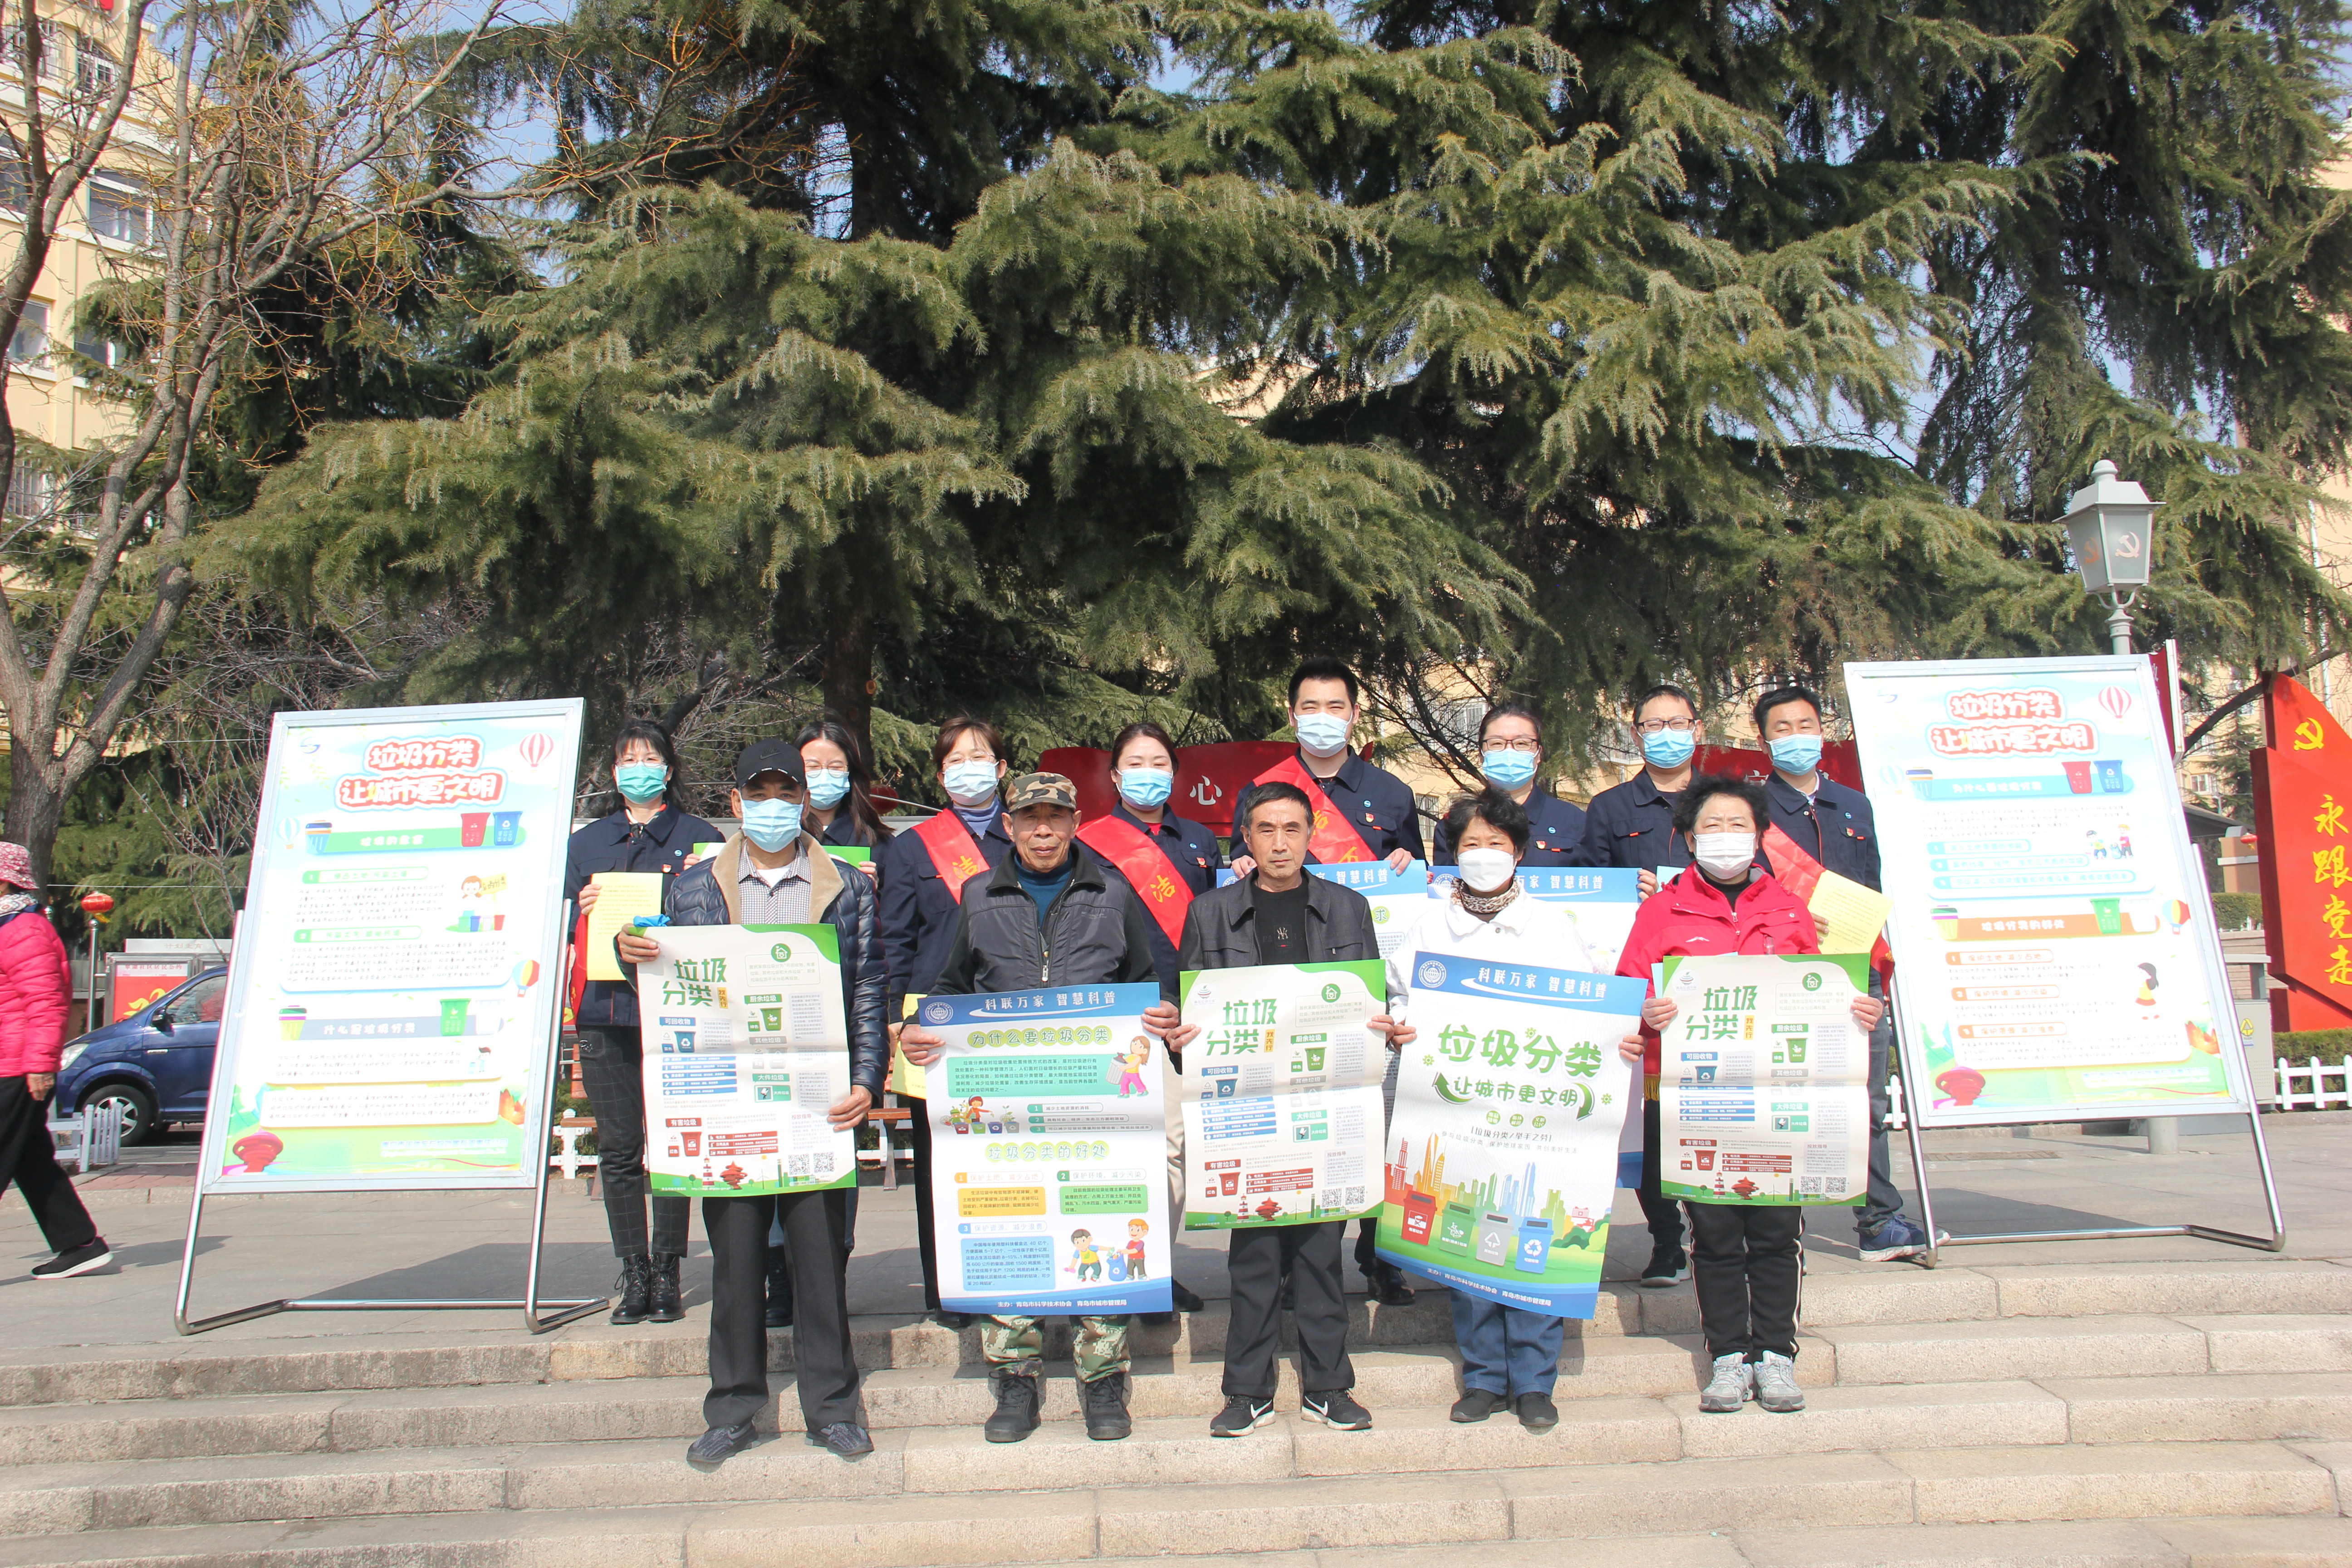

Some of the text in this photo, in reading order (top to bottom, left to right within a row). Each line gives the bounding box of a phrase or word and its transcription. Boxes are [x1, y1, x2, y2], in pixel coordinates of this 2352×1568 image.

[1952, 693, 2055, 717] 垃圾分类
[1932, 725, 2088, 751] 让城市更文明
[371, 740, 474, 768] 垃圾分类
[342, 774, 496, 804] 让城市更文明
[1190, 775, 1222, 805] 心
[952, 855, 978, 879] 洁
[1336, 869, 1388, 884] 智慧科普
[1150, 875, 1176, 903] 洁
[1550, 875, 1603, 889] 智慧科普
[2313, 794, 2352, 985] 永跟党走
[1374, 908, 1387, 922] 求
[1981, 919, 2064, 931] 垃圾分类的好处
[674, 957, 727, 983] 垃圾
[662, 980, 713, 1007] 分类
[1478, 967, 1607, 999] 科联万家 智慧科普
[985, 991, 1116, 1011] 科联万家 智慧科普
[1702, 985, 1758, 1011] 垃圾
[1222, 998, 1277, 1025] 垃圾
[324, 1022, 416, 1036] 什么是垃圾分类
[971, 1028, 1110, 1046] 为什么要垃圾分类
[1296, 1034, 1322, 1043] 厨余垃圾
[1686, 1014, 1739, 1040] 分类
[1745, 1018, 1754, 1039] 我先行
[1206, 1029, 1259, 1056] 分类
[1265, 1031, 1274, 1051] 我先行
[1437, 1023, 1602, 1078] 垃圾分类
[1454, 1076, 1578, 1107] 让城市更文明
[1297, 1112, 1322, 1120] 大件垃圾
[988, 1144, 1107, 1160] 垃圾分类的好处
[1442, 1131, 1578, 1154] 参与垃圾分类 保护地球家园 共创美好生活
[1210, 1161, 1236, 1169] 有害垃圾
[1502, 1290, 1552, 1307] 青岛市城市管理局
